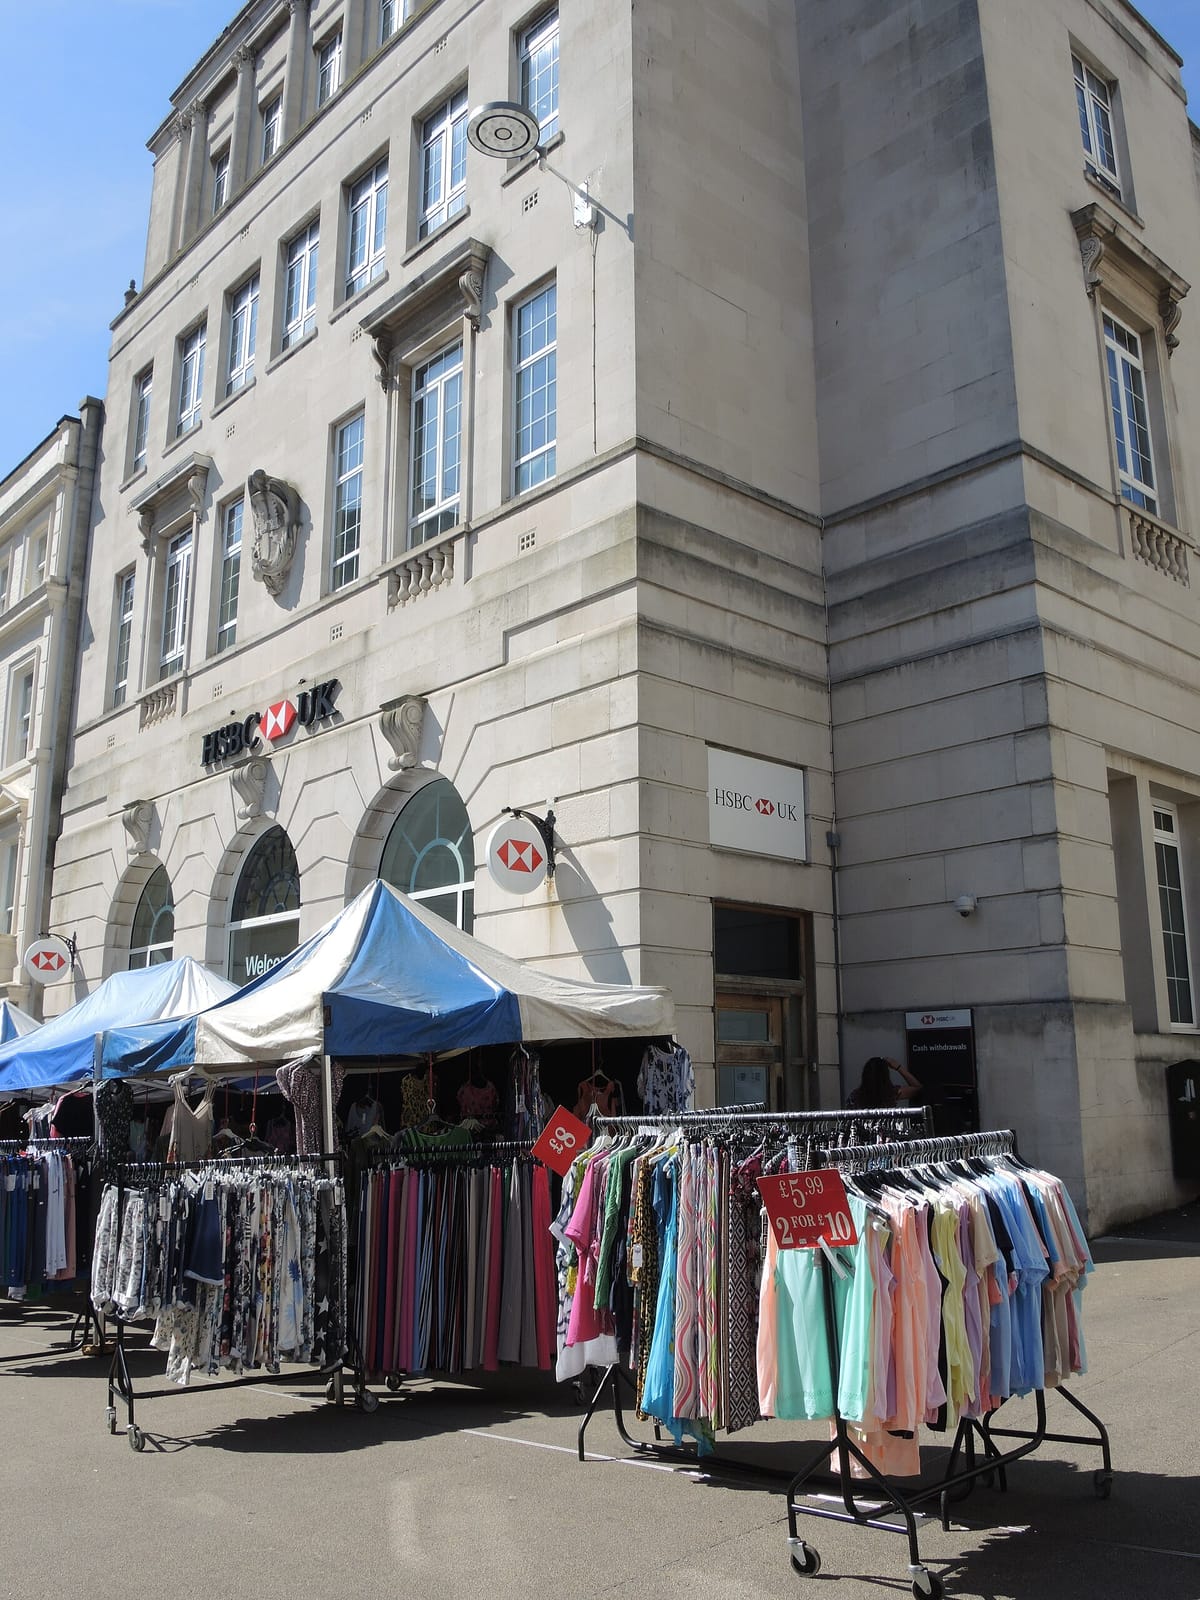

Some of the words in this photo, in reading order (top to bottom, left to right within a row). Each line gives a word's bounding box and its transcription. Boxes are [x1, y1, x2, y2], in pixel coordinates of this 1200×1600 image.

[200, 712, 262, 767] HSBC
[296, 678, 340, 727] UK
[715, 788, 752, 812] HSBC
[777, 802, 797, 821] UK
[912, 1044, 928, 1052] Cash
[929, 1043, 967, 1052] withdrawals
[549, 1126, 576, 1154] £8
[779, 1175, 824, 1208] £5.99
[776, 1216, 794, 1244] 2
[791, 1214, 816, 1228] FOR
[817, 1211, 851, 1240] £10
